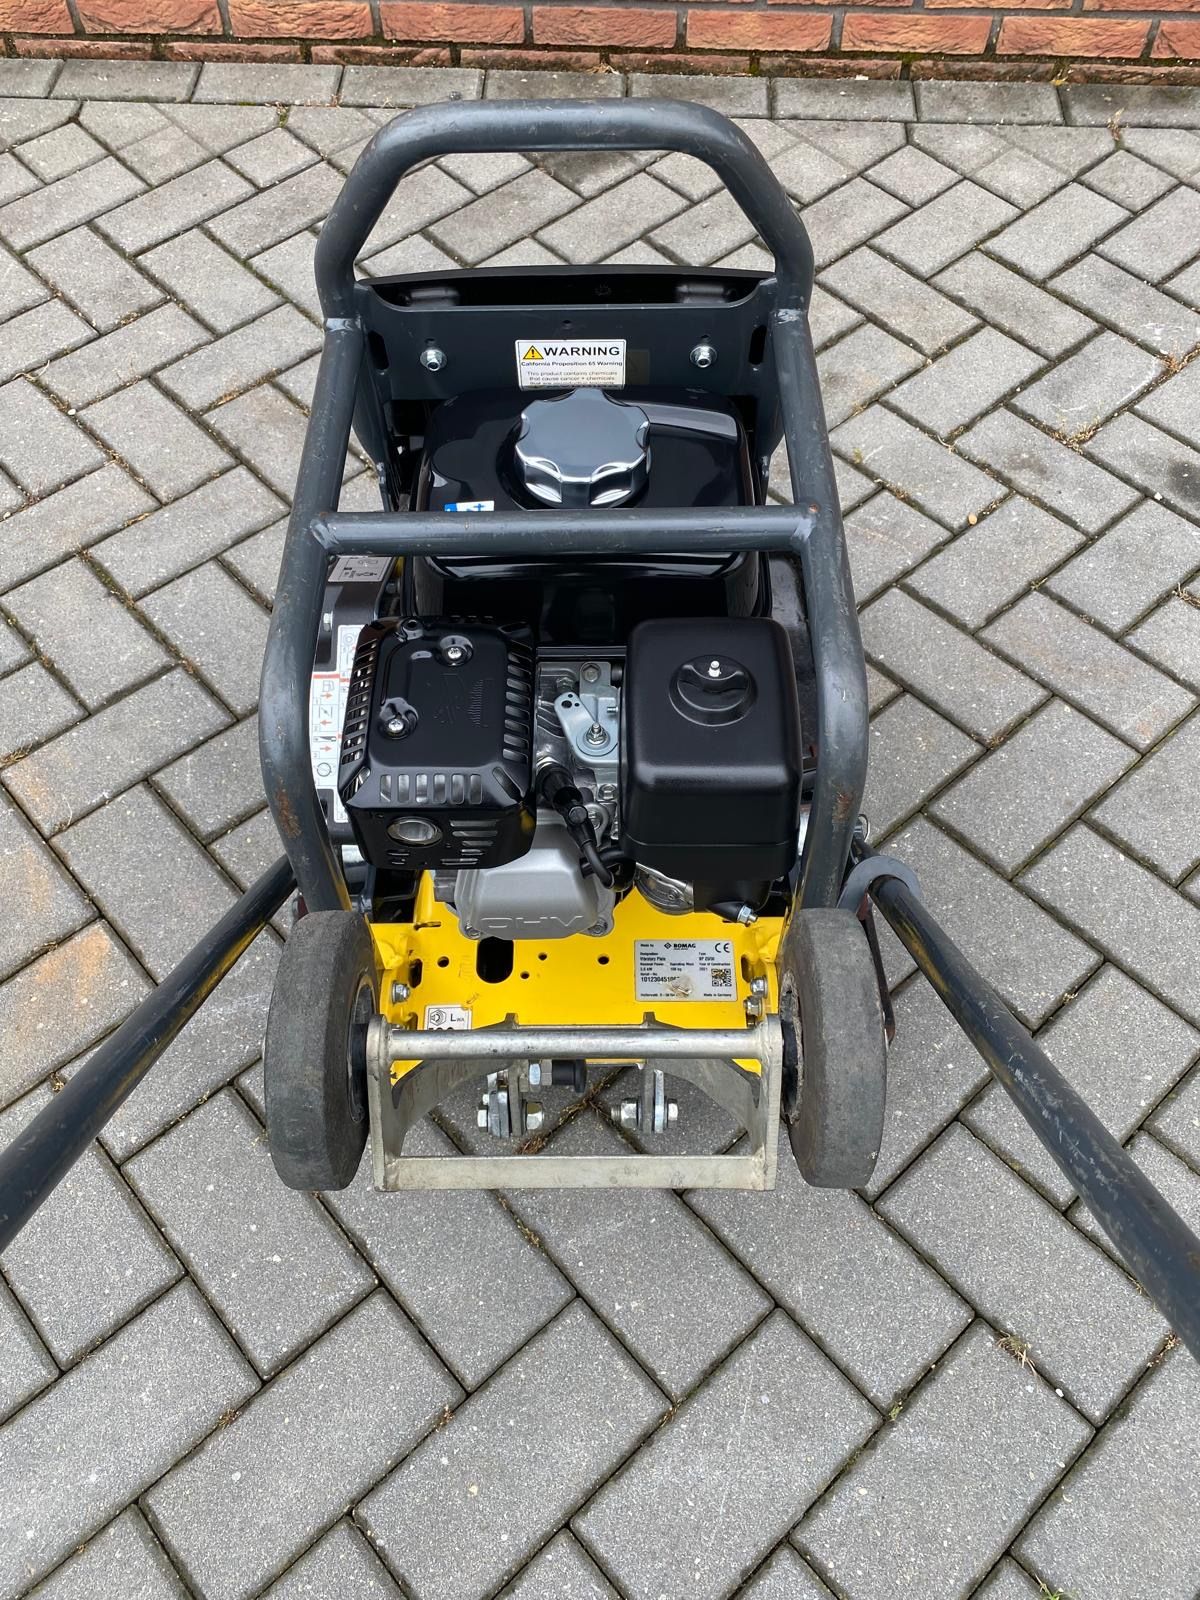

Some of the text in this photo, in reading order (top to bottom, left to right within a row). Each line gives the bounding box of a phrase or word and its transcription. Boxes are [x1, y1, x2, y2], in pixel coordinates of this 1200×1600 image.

[543, 346, 620, 356] WARNING
[480, 915, 583, 929] OHV
[714, 942, 731, 953] CE
